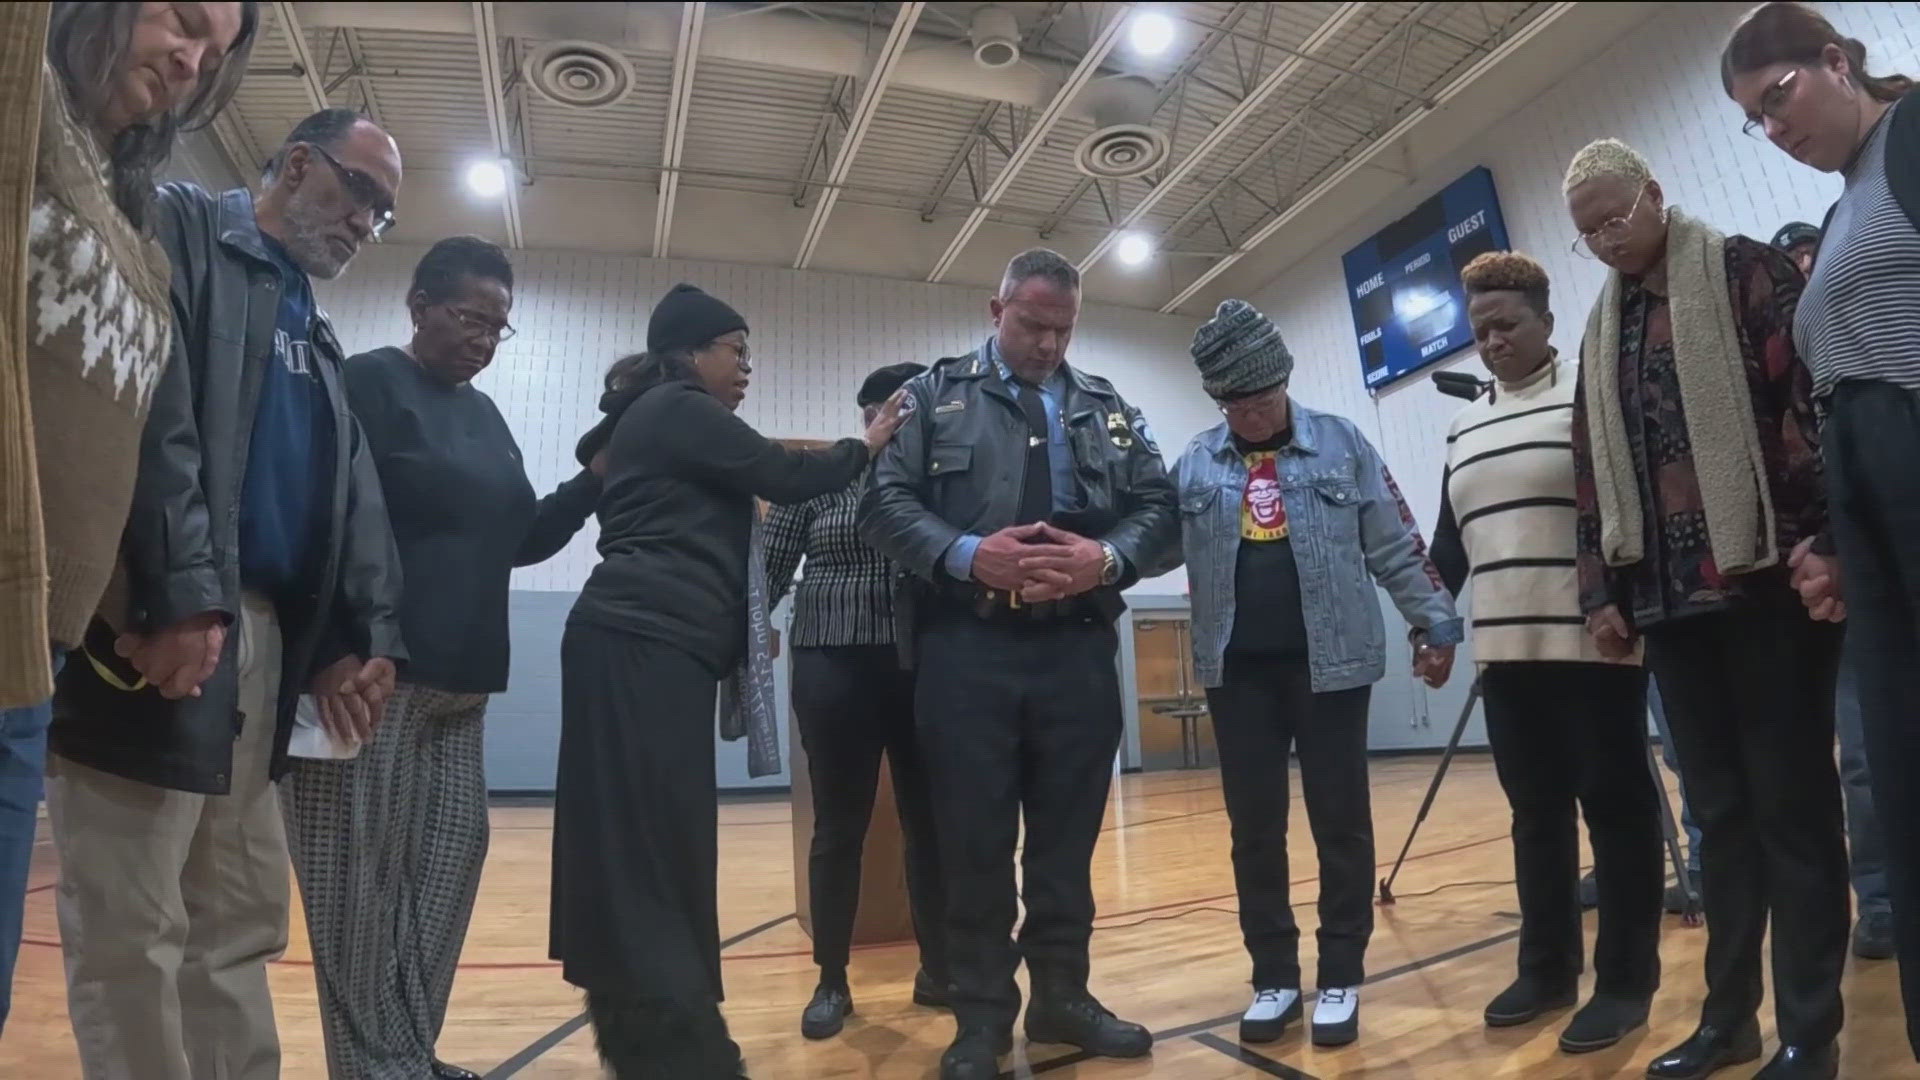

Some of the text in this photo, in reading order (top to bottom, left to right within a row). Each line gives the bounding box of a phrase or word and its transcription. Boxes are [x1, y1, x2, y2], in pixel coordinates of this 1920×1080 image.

[1447, 209, 1486, 244] GUEST
[1404, 252, 1431, 275] PERIOD
[1356, 271, 1385, 299] HOME
[1360, 327, 1382, 346] FOULS
[1420, 336, 1449, 357] MATCH
